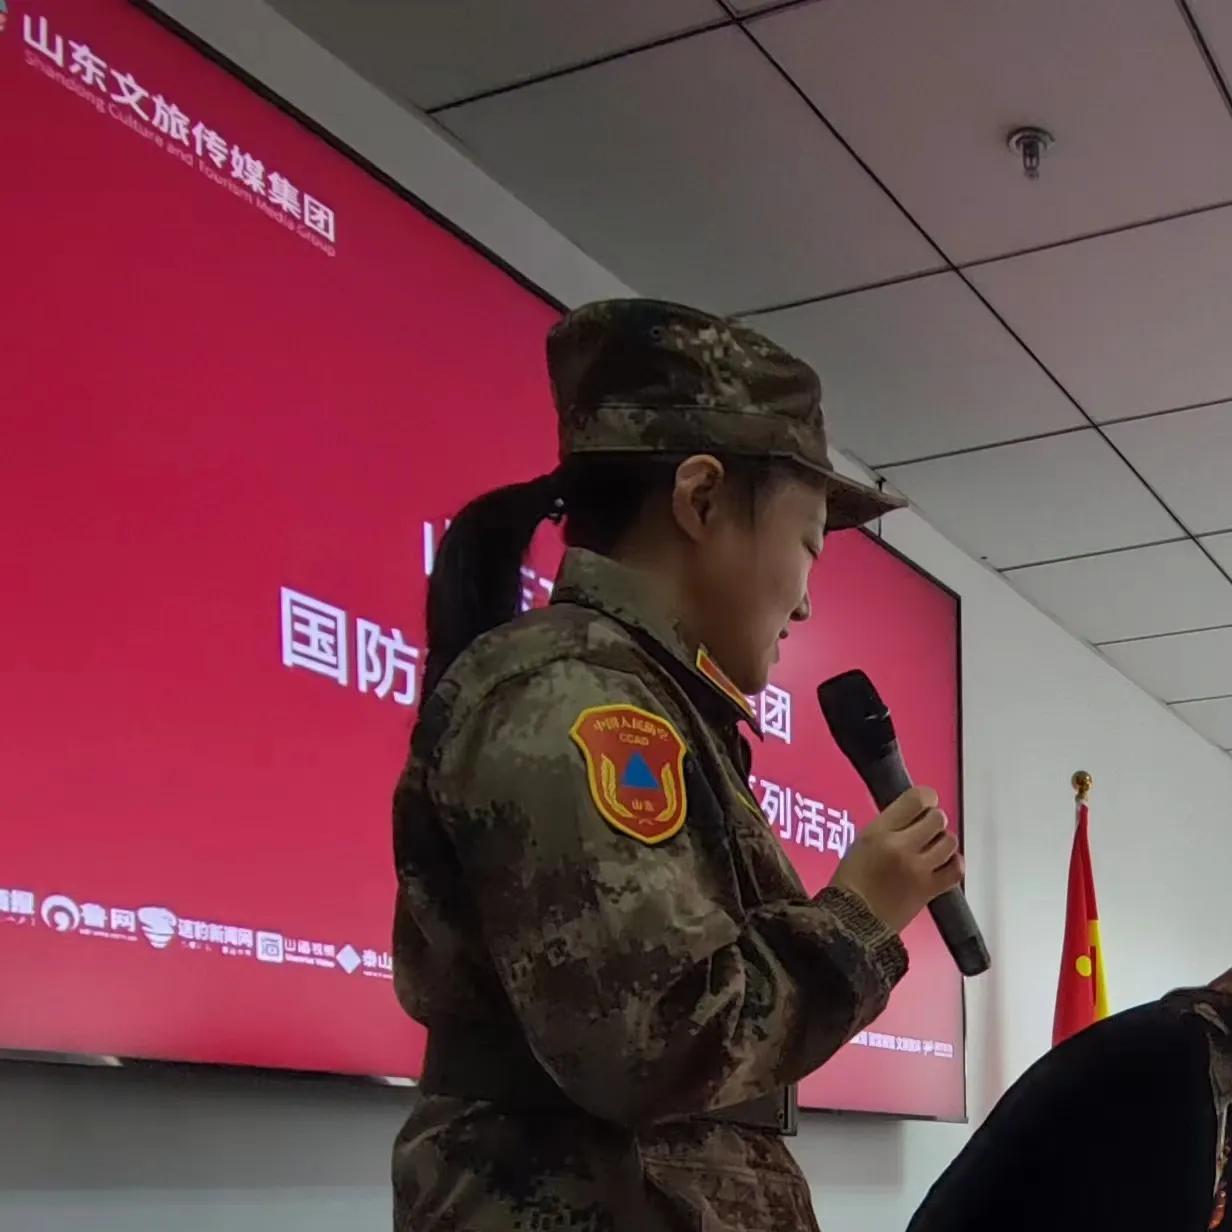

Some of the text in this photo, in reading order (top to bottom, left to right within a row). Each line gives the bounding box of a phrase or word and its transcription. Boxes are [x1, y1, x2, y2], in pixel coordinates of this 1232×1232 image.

[23, 13, 336, 243] 山东文旅传媒集团
[24, 48, 337, 257] Shandong Culture and Tourism Media Group
[748, 775, 855, 860] 列活动
